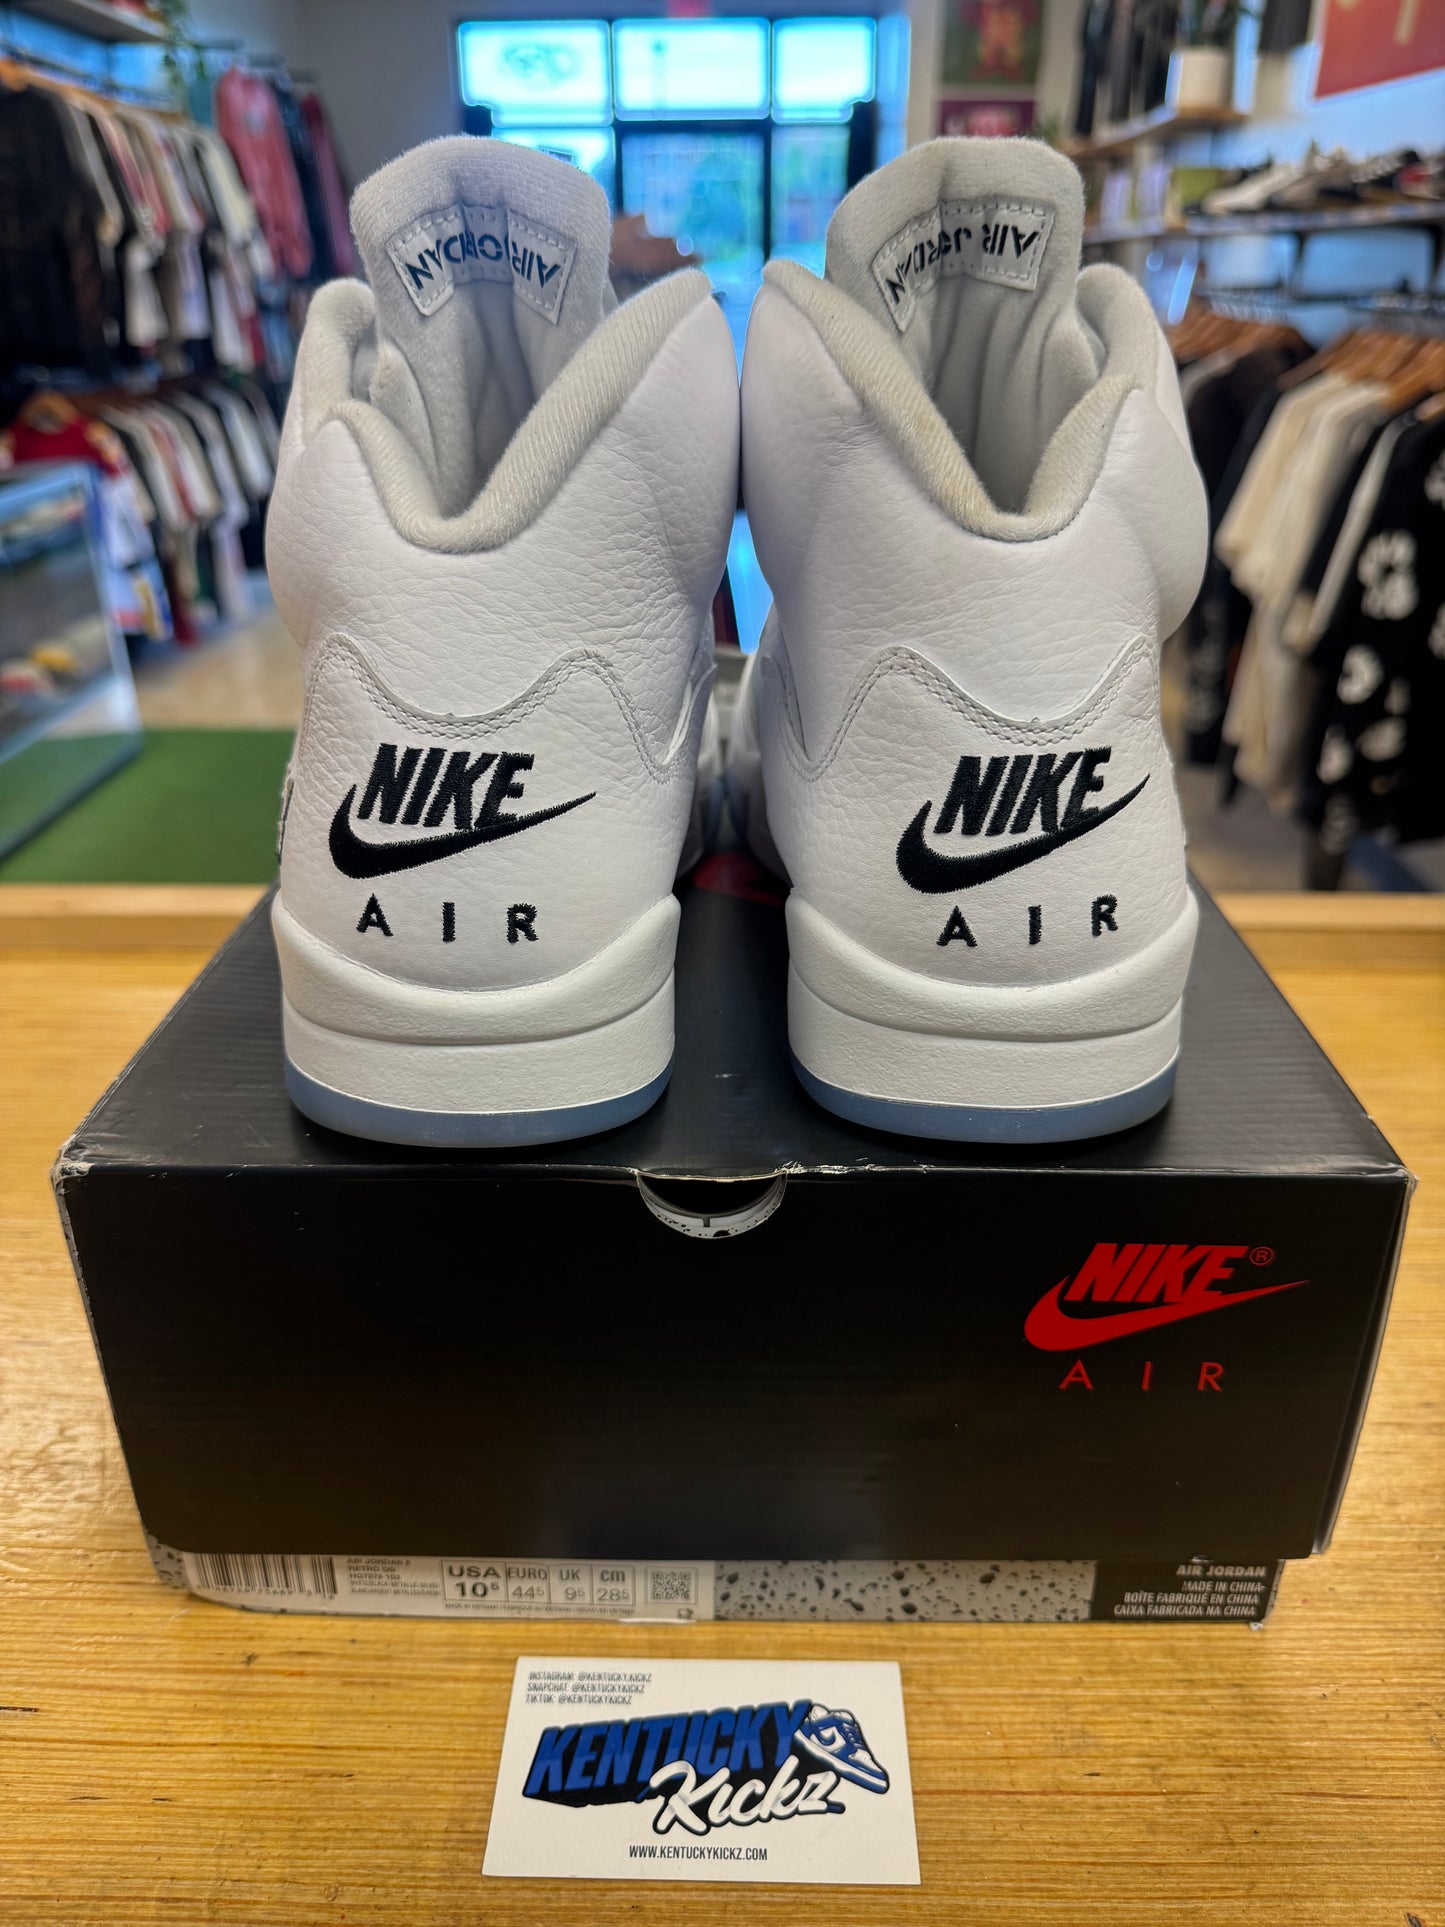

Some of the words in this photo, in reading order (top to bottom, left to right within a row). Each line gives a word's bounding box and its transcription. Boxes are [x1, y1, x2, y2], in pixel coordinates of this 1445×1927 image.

[982, 223, 1040, 259] AIR
[511, 240, 562, 289] AIR
[356, 742, 535, 830] NIKE
[933, 746, 1112, 836] NIKE
[356, 893, 539, 943] AIR
[936, 894, 1118, 947] AIR
[1063, 1243, 1249, 1303] NIKE
[1059, 1359, 1223, 1391] AIR
[449, 1565, 501, 1578] USA
[508, 1566, 548, 1581] EURO
[560, 1568, 580, 1581] UK
[600, 1568, 626, 1582] cm
[1176, 1565, 1201, 1576] AIR
[1206, 1566, 1267, 1577] JORDAN
[1182, 1580, 1213, 1592] MADE
[1215, 1581, 1227, 1592] IN
[1113, 1604, 1144, 1616] CAIXA
[1146, 1604, 1204, 1616] FABRICADA
[1206, 1605, 1220, 1616] NA
[1223, 1605, 1257, 1616] CHINA
[1210, 1594, 1223, 1604] EN
[1226, 1594, 1259, 1605] CHINA
[524, 1700, 813, 1798] KENTUCKY
[628, 1845, 768, 1861] WWW.KENTUCKYKICKZ.COM
